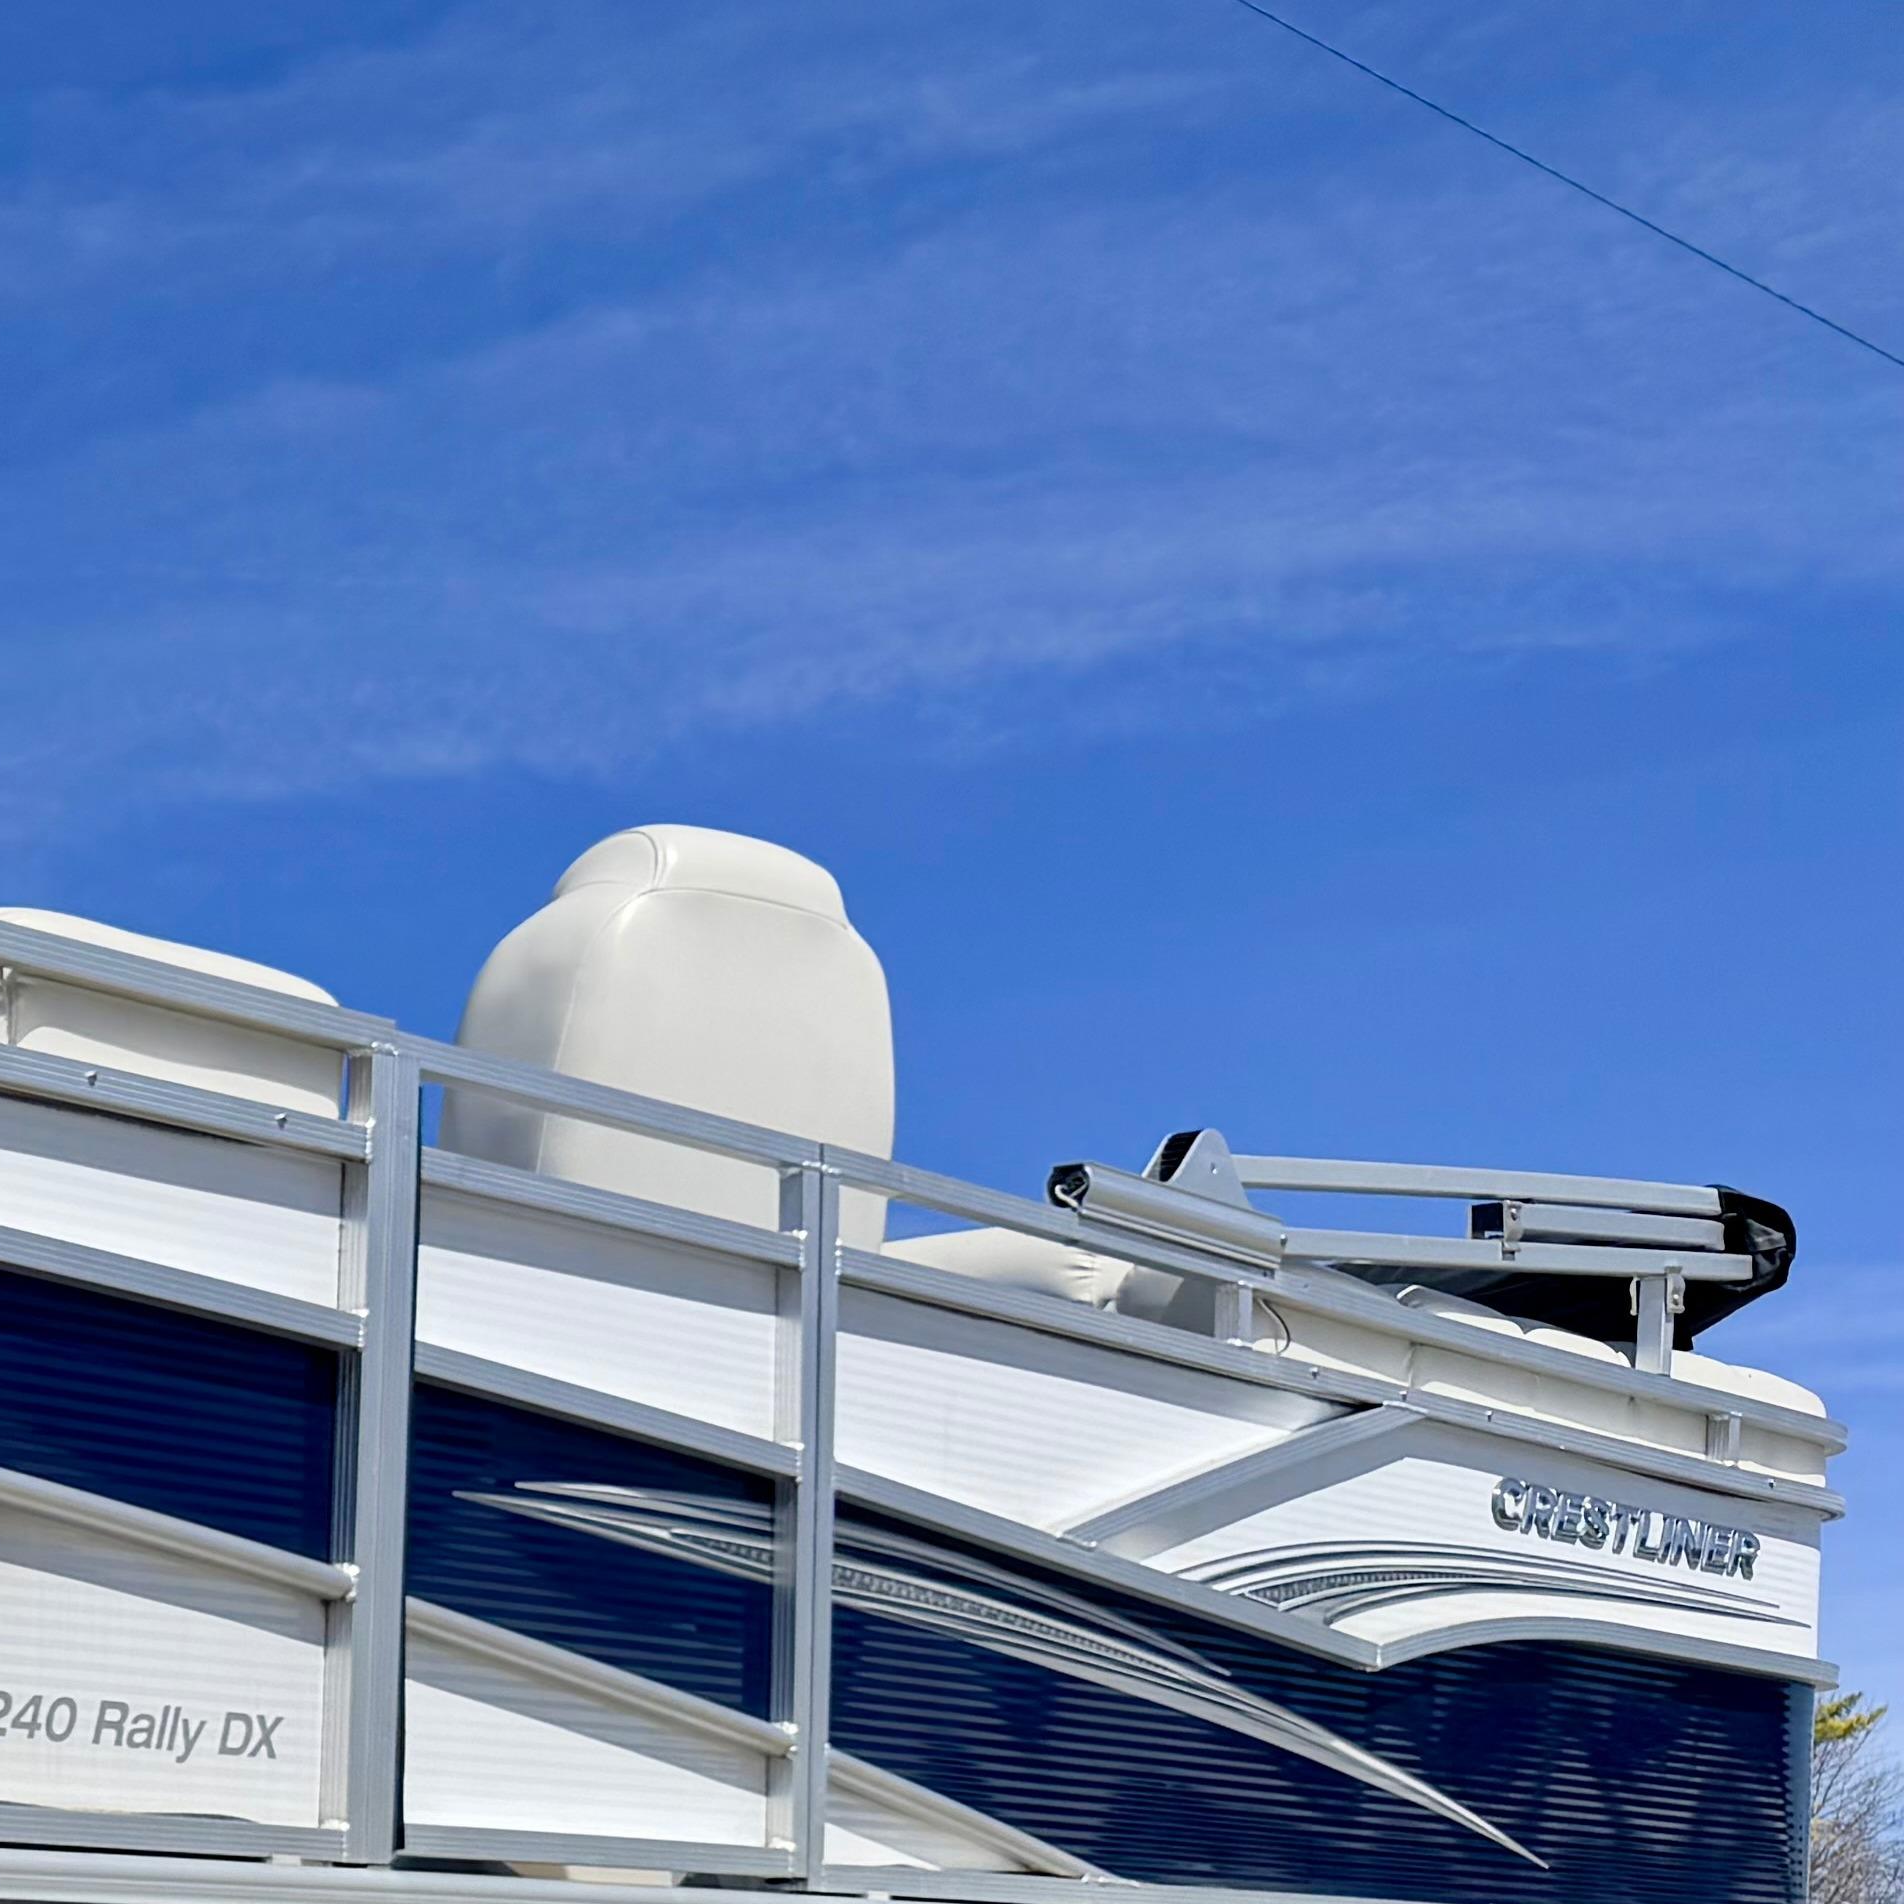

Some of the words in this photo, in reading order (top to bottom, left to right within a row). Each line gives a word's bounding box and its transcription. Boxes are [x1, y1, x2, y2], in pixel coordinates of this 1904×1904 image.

[1492, 1477, 1761, 1580] CRESTLINER
[92, 1700, 206, 1763] Rally
[218, 1712, 284, 1759] DX
